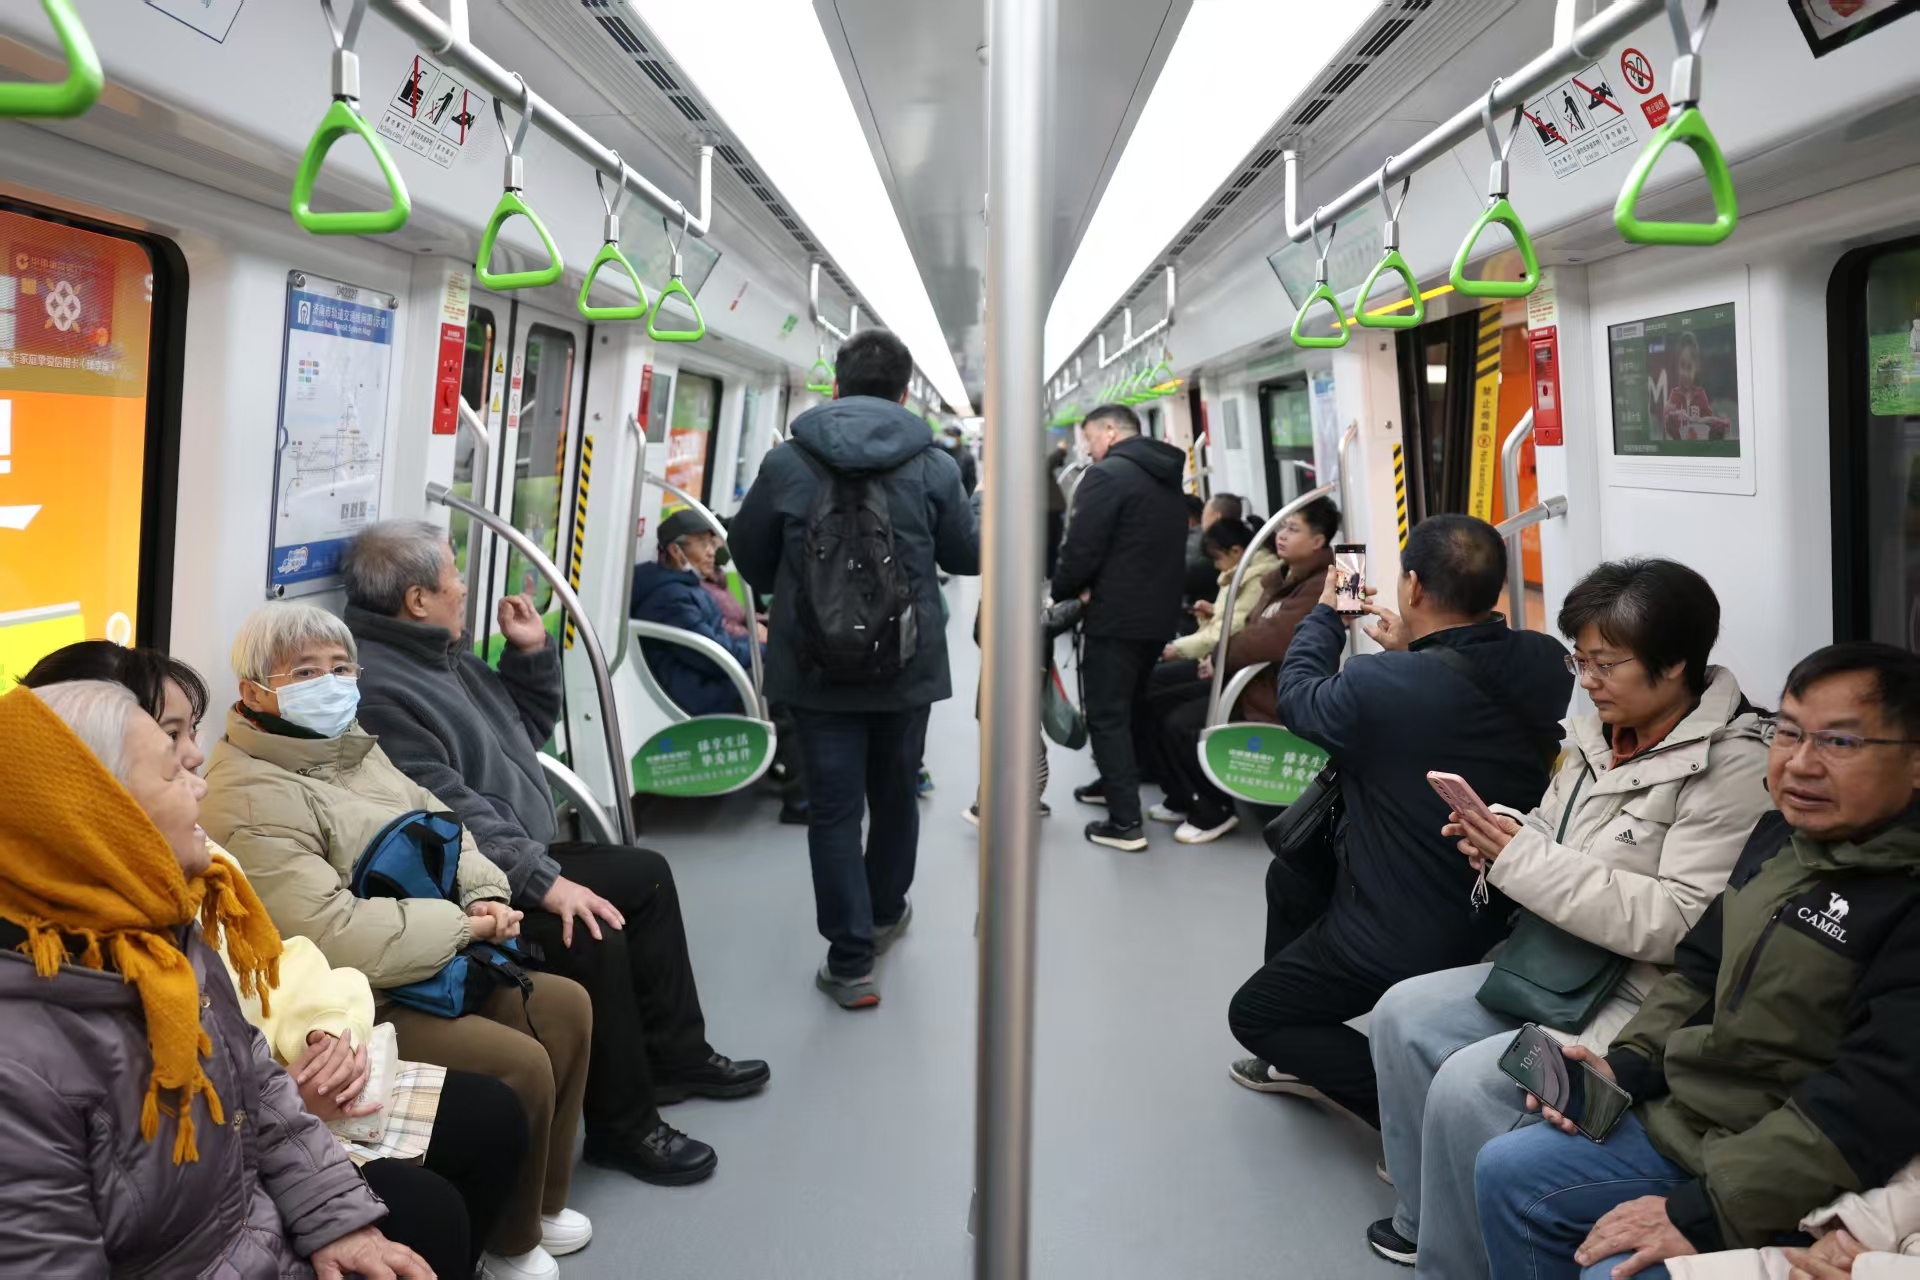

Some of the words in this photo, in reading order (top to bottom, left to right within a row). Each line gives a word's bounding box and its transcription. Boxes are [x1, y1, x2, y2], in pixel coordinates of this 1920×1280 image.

[1614, 836, 1637, 846] adidas
[1797, 907, 1847, 944] CAMEL
[1520, 1044, 1542, 1070] 10:14
